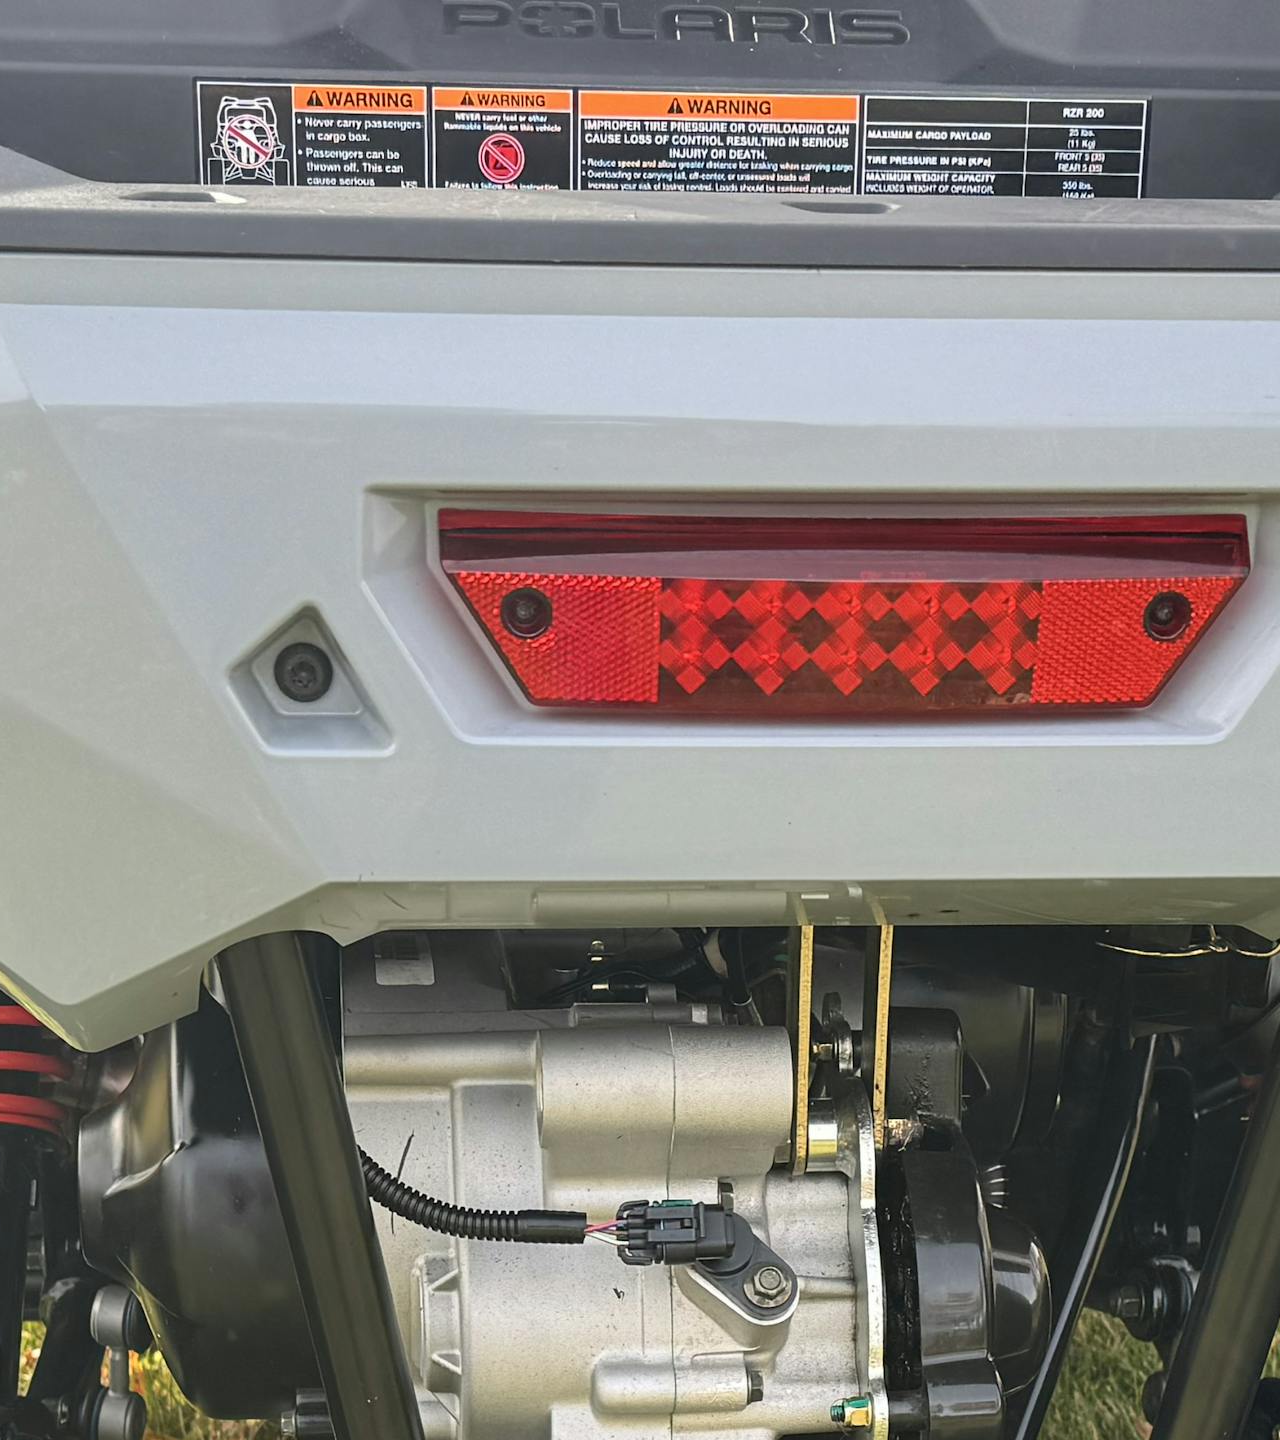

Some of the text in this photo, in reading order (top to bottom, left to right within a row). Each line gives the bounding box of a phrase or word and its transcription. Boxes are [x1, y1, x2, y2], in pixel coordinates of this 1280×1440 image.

[442, 1, 910, 45] POLARIS
[326, 91, 413, 108] WARNING
[477, 94, 546, 107] WARNING
[688, 99, 771, 115] WARNING
[1063, 108, 1104, 118] RZR 200
[455, 112, 480, 121] NEVER
[482, 114, 501, 123] carry
[305, 117, 421, 131] Never carry passengers
[444, 122, 481, 131] flammable
[483, 122, 507, 132] liquids
[520, 123, 534, 132] this
[535, 124, 561, 133] vehicle
[584, 120, 849, 134] IMPROPER TIRE PRESSURE OR OVERLOADING CAN
[306, 131, 370, 143] in cargo box.
[585, 133, 849, 148] CAUSE LOSS OF CONTROL RESULTING IN SERIOUS
[867, 129, 991, 141] MAXIMUM CARGO PAYLOAD
[1068, 139, 1096, 150] (11 Kg)
[305, 147, 400, 160] Passengers can be
[669, 148, 767, 160] INJURY OR DEATH.
[1055, 152, 1082, 161] FRONT
[587, 158, 853, 172] Reduce speed and allow greater distance for braking when carrying cargo
[867, 155, 887, 165] TIRE
[889, 156, 937, 165] PRESSURE
[940, 157, 949, 165] IN
[951, 157, 966, 166] PSI
[306, 161, 403, 173] thrown off. This can
[1058, 163, 1081, 172] REAR
[587, 170, 632, 180] Overloading
[643, 171, 672, 181] carrying
[777, 173, 797, 181] loads
[866, 172, 996, 183] MAXIMUM WEIGHT CAPACITY
[307, 177, 375, 187] cause serious
[588, 182, 618, 190] increase
[620, 183, 637, 191] your
[639, 182, 651, 190] risk
[653, 182, 660, 190] of
[715, 183, 738, 191] Loads
[866, 184, 905, 193] INCLUDES
[906, 184, 937, 193] WEIGHT
[938, 185, 949, 193] OF
